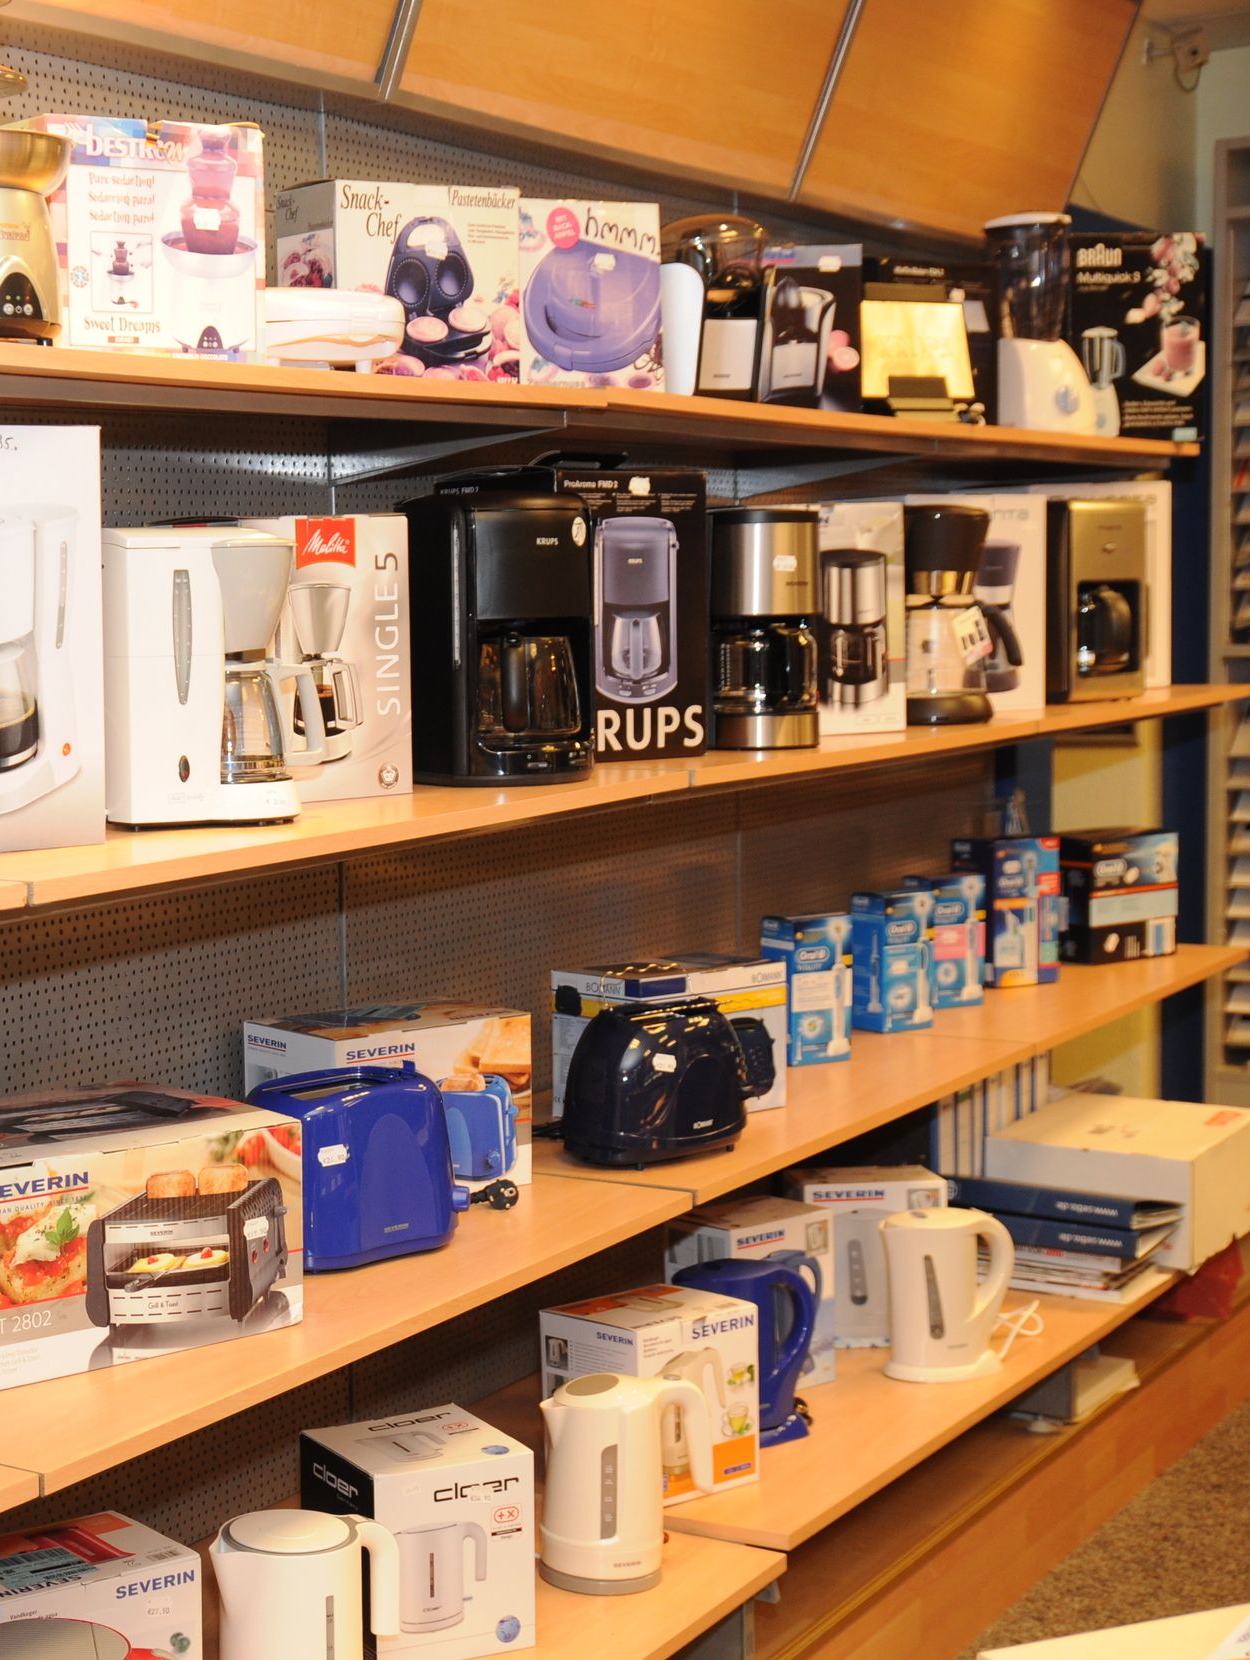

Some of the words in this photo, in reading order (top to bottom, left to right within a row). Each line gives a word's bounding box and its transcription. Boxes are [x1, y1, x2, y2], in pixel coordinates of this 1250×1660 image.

[341, 184, 389, 210] Snack-
[451, 189, 516, 209] Pastetenbäcker
[366, 212, 401, 244] Chef
[84, 316, 115, 333] Sweet
[118, 318, 162, 335] Dreams
[563, 478, 597, 489] ProAroma
[301, 528, 349, 556] Melitta
[536, 537, 559, 546] KRUPS
[375, 552, 399, 571] 5
[375, 582, 401, 716] SINGLE
[597, 704, 705, 752] RUPS
[247, 1034, 287, 1050] SEVERIN
[346, 1042, 416, 1060] SEVERIN
[813, 1189, 885, 1198] SEVERIN
[736, 1229, 785, 1247] SEVERIN
[12, 1310, 52, 1333] 2802
[692, 1314, 754, 1340] SEVERIN
[596, 1331, 634, 1346] SEVERIN
[368, 1412, 451, 1432] cloer
[313, 1462, 359, 1498] cloer
[117, 1570, 195, 1600] SEVERIN
